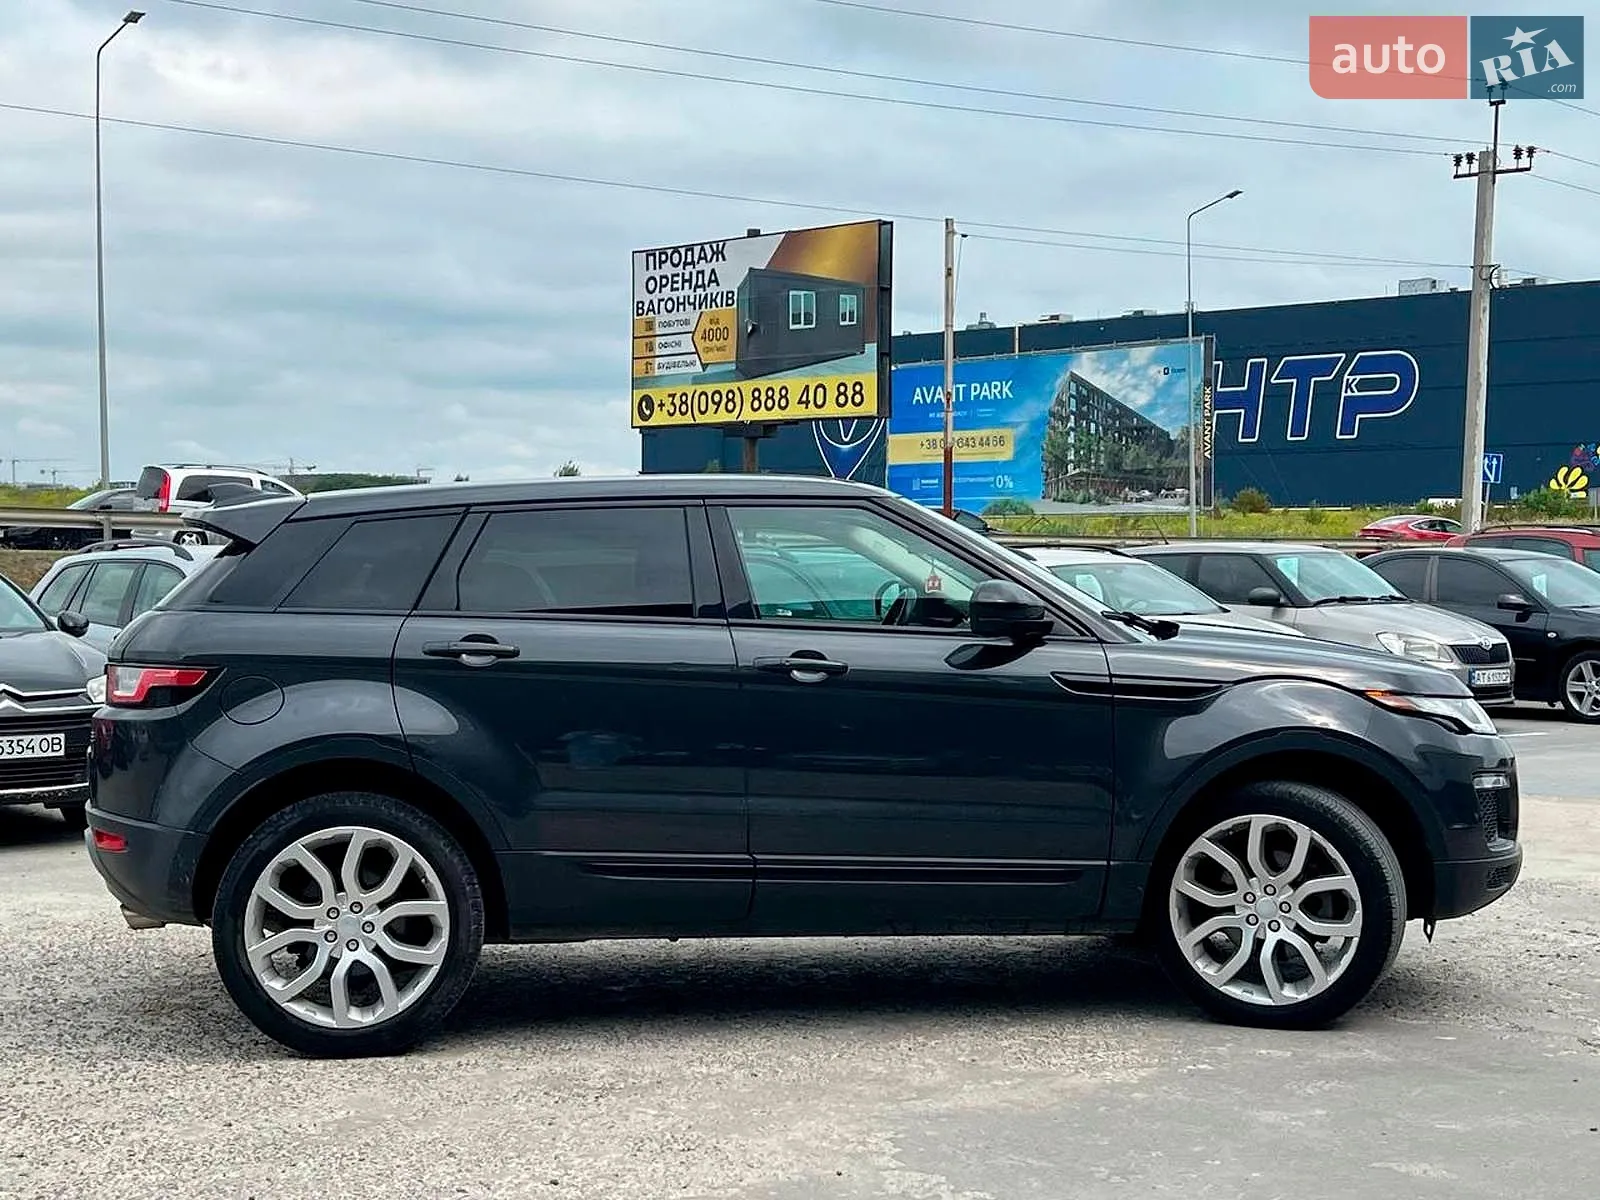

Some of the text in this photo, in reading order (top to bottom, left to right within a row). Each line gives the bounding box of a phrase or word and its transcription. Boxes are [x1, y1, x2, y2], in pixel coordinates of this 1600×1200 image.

[645, 242, 727, 272] ПРОДАЖ
[645, 268, 720, 295] ОРЕНДА
[636, 290, 736, 317] ВАГОНЧИКІВ
[701, 326, 729, 342] 4000
[657, 381, 864, 422] +38(098) 888 40 88
[912, 380, 1014, 405] AVAT PARK
[1204, 386, 1212, 459] AVANT PARK
[39, 736, 63, 753] OB
